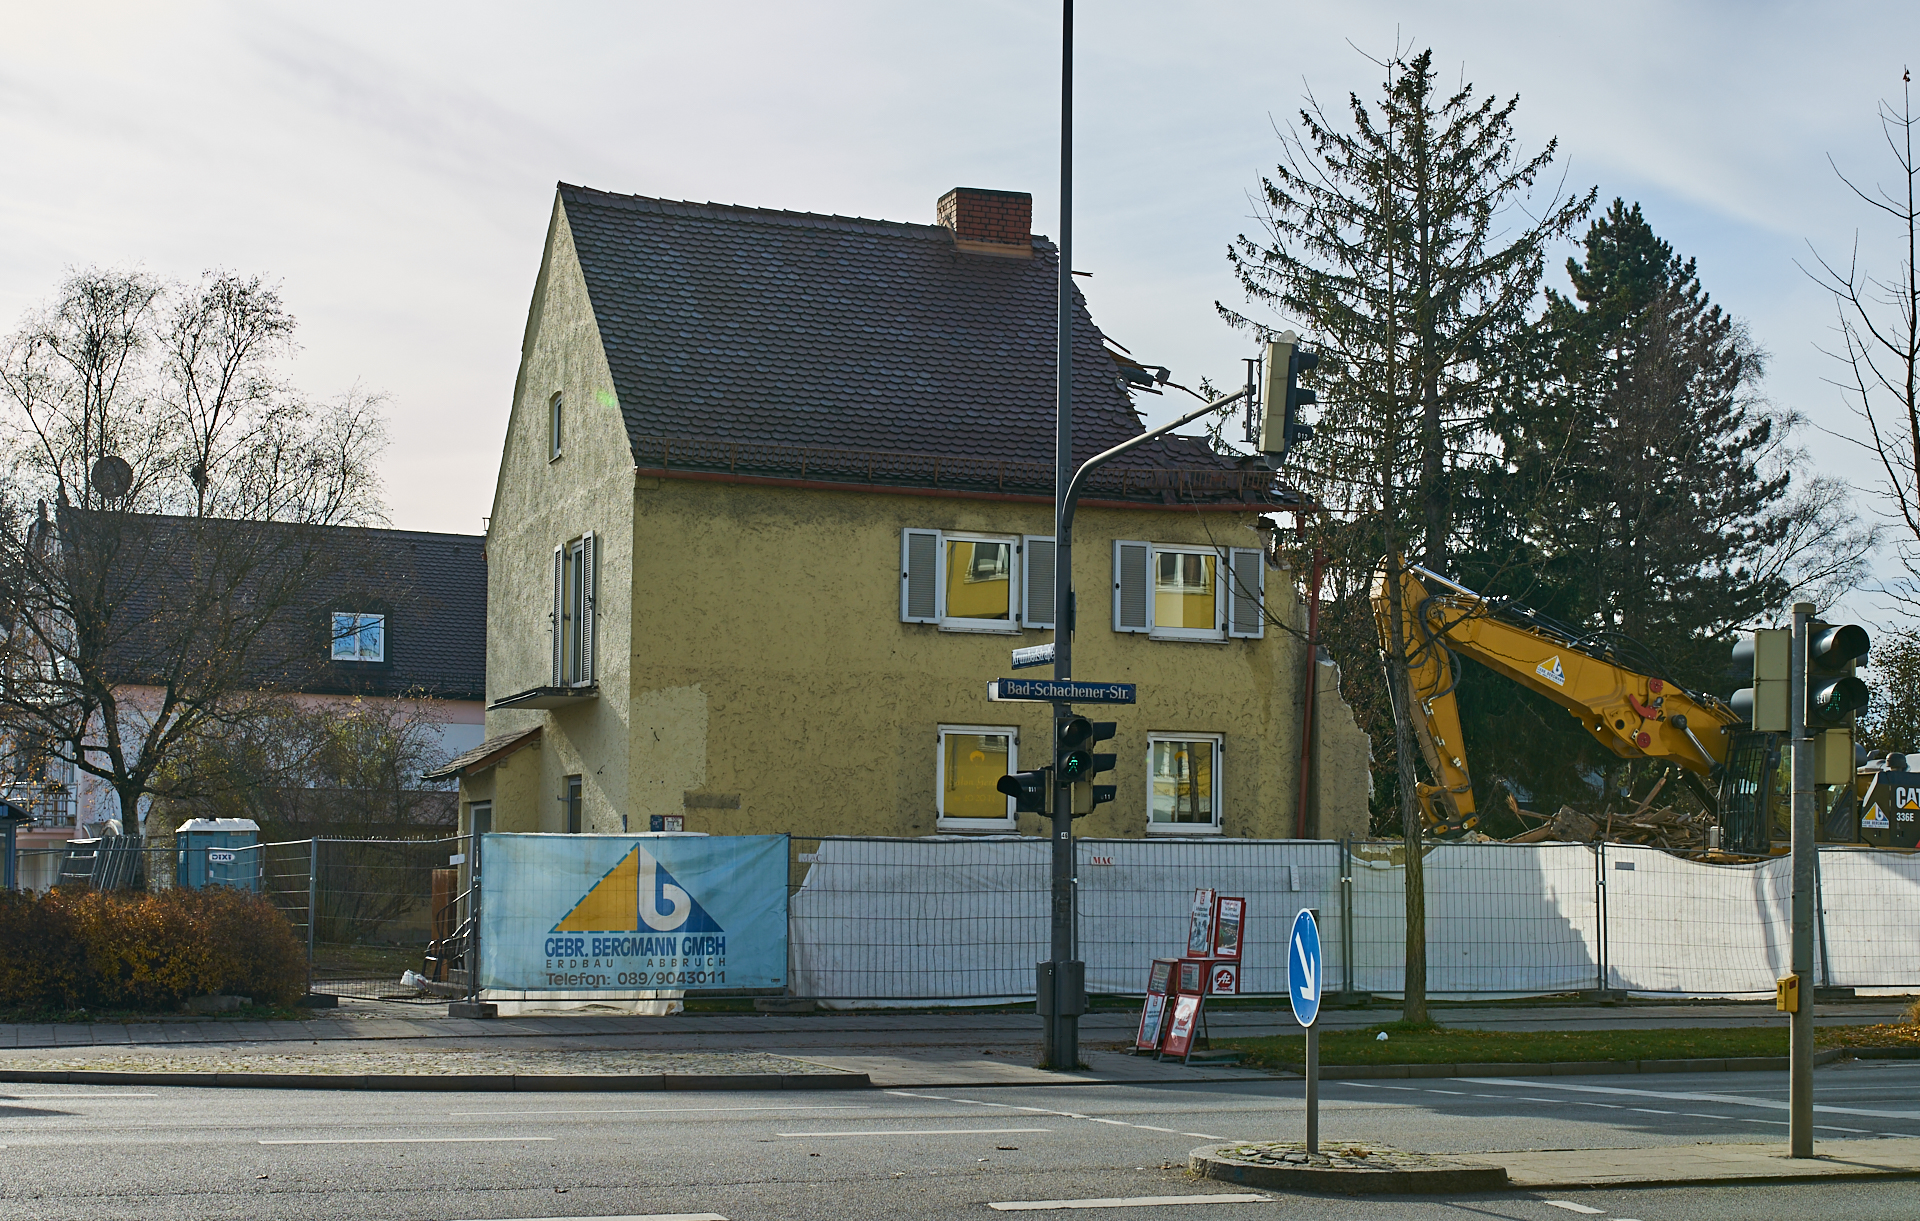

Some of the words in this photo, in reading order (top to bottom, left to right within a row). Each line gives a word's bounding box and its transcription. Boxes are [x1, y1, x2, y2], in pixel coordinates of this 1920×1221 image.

[1007, 681, 1129, 699] Bad-Schachener-Str.
[1896, 812, 1915, 822] 336E
[1093, 856, 1114, 864] MAC
[545, 937, 589, 958] GEBR.
[592, 936, 677, 957] BERGMANN
[682, 936, 726, 956] GMBH
[546, 959, 614, 969] ERDBAU
[646, 957, 726, 968] ABBRUCH
[546, 971, 611, 986] Telefon:
[617, 970, 726, 986] 089/9043011
